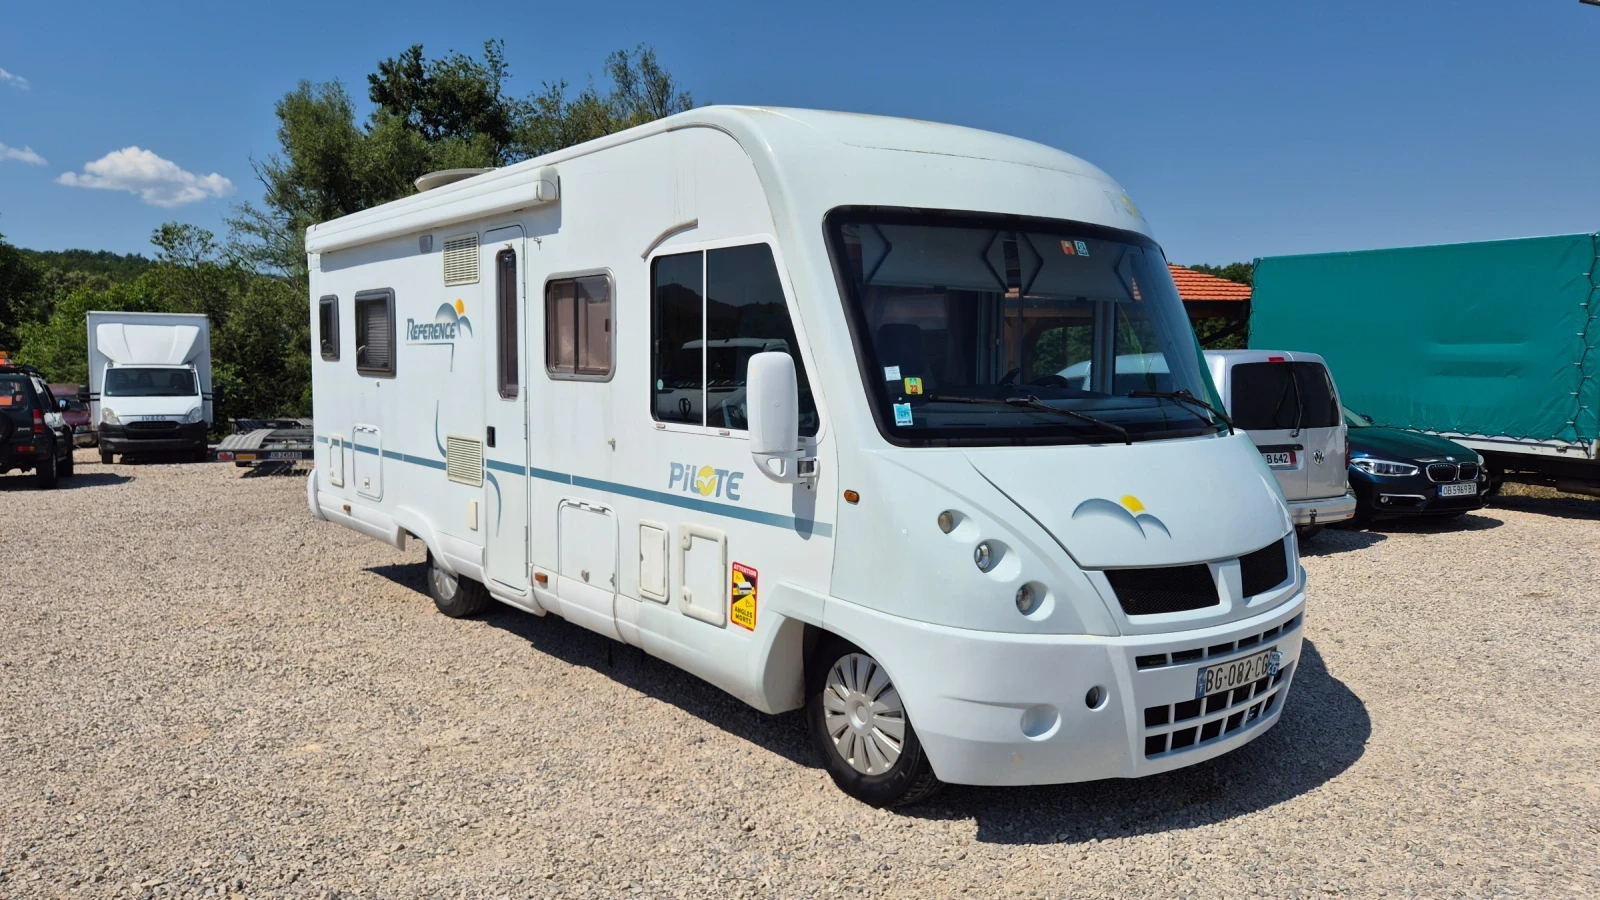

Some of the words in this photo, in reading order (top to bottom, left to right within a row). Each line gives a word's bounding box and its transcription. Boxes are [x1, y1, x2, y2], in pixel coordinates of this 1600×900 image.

[733, 563, 757, 578] ATTENTION
[735, 606, 753, 619] ANGLES
[735, 613, 752, 625] MORTS
